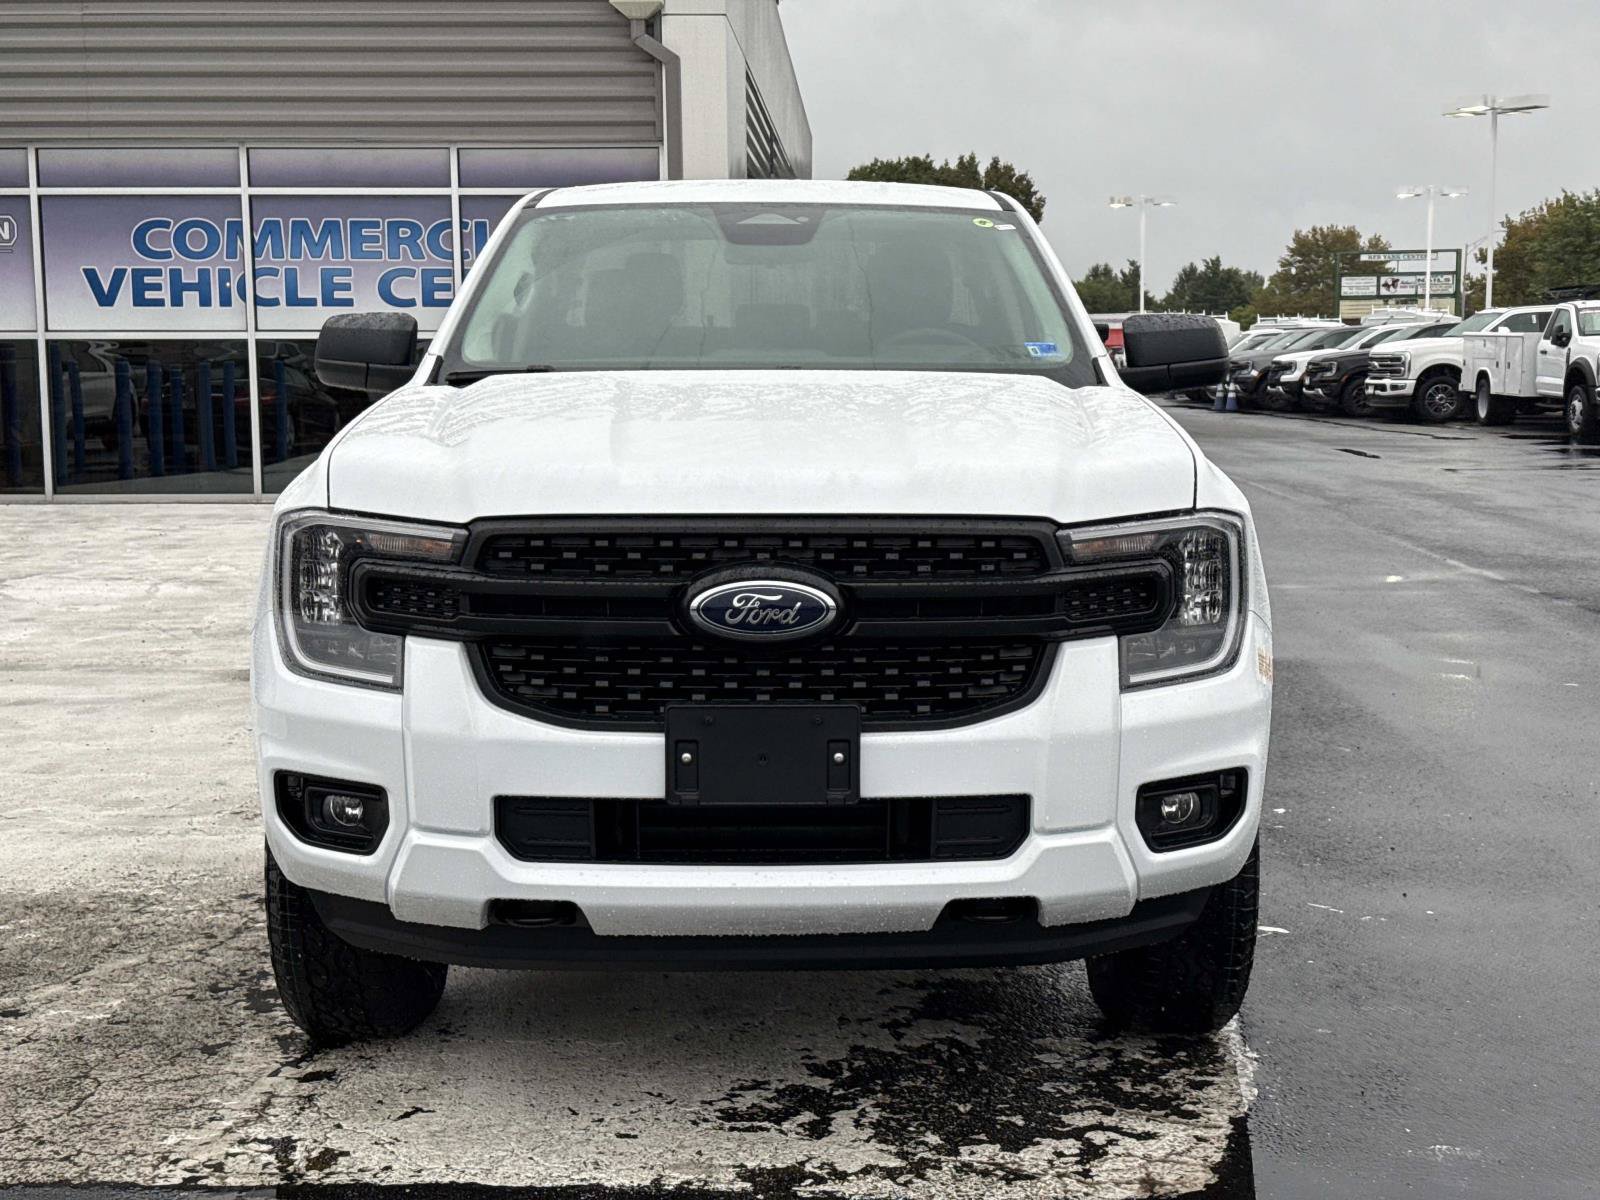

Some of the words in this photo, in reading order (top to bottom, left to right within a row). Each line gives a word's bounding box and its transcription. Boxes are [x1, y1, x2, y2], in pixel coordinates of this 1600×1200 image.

[81, 266, 355, 308] VEHICLE
[376, 266, 471, 308] CE
[725, 593, 802, 625] Ford
